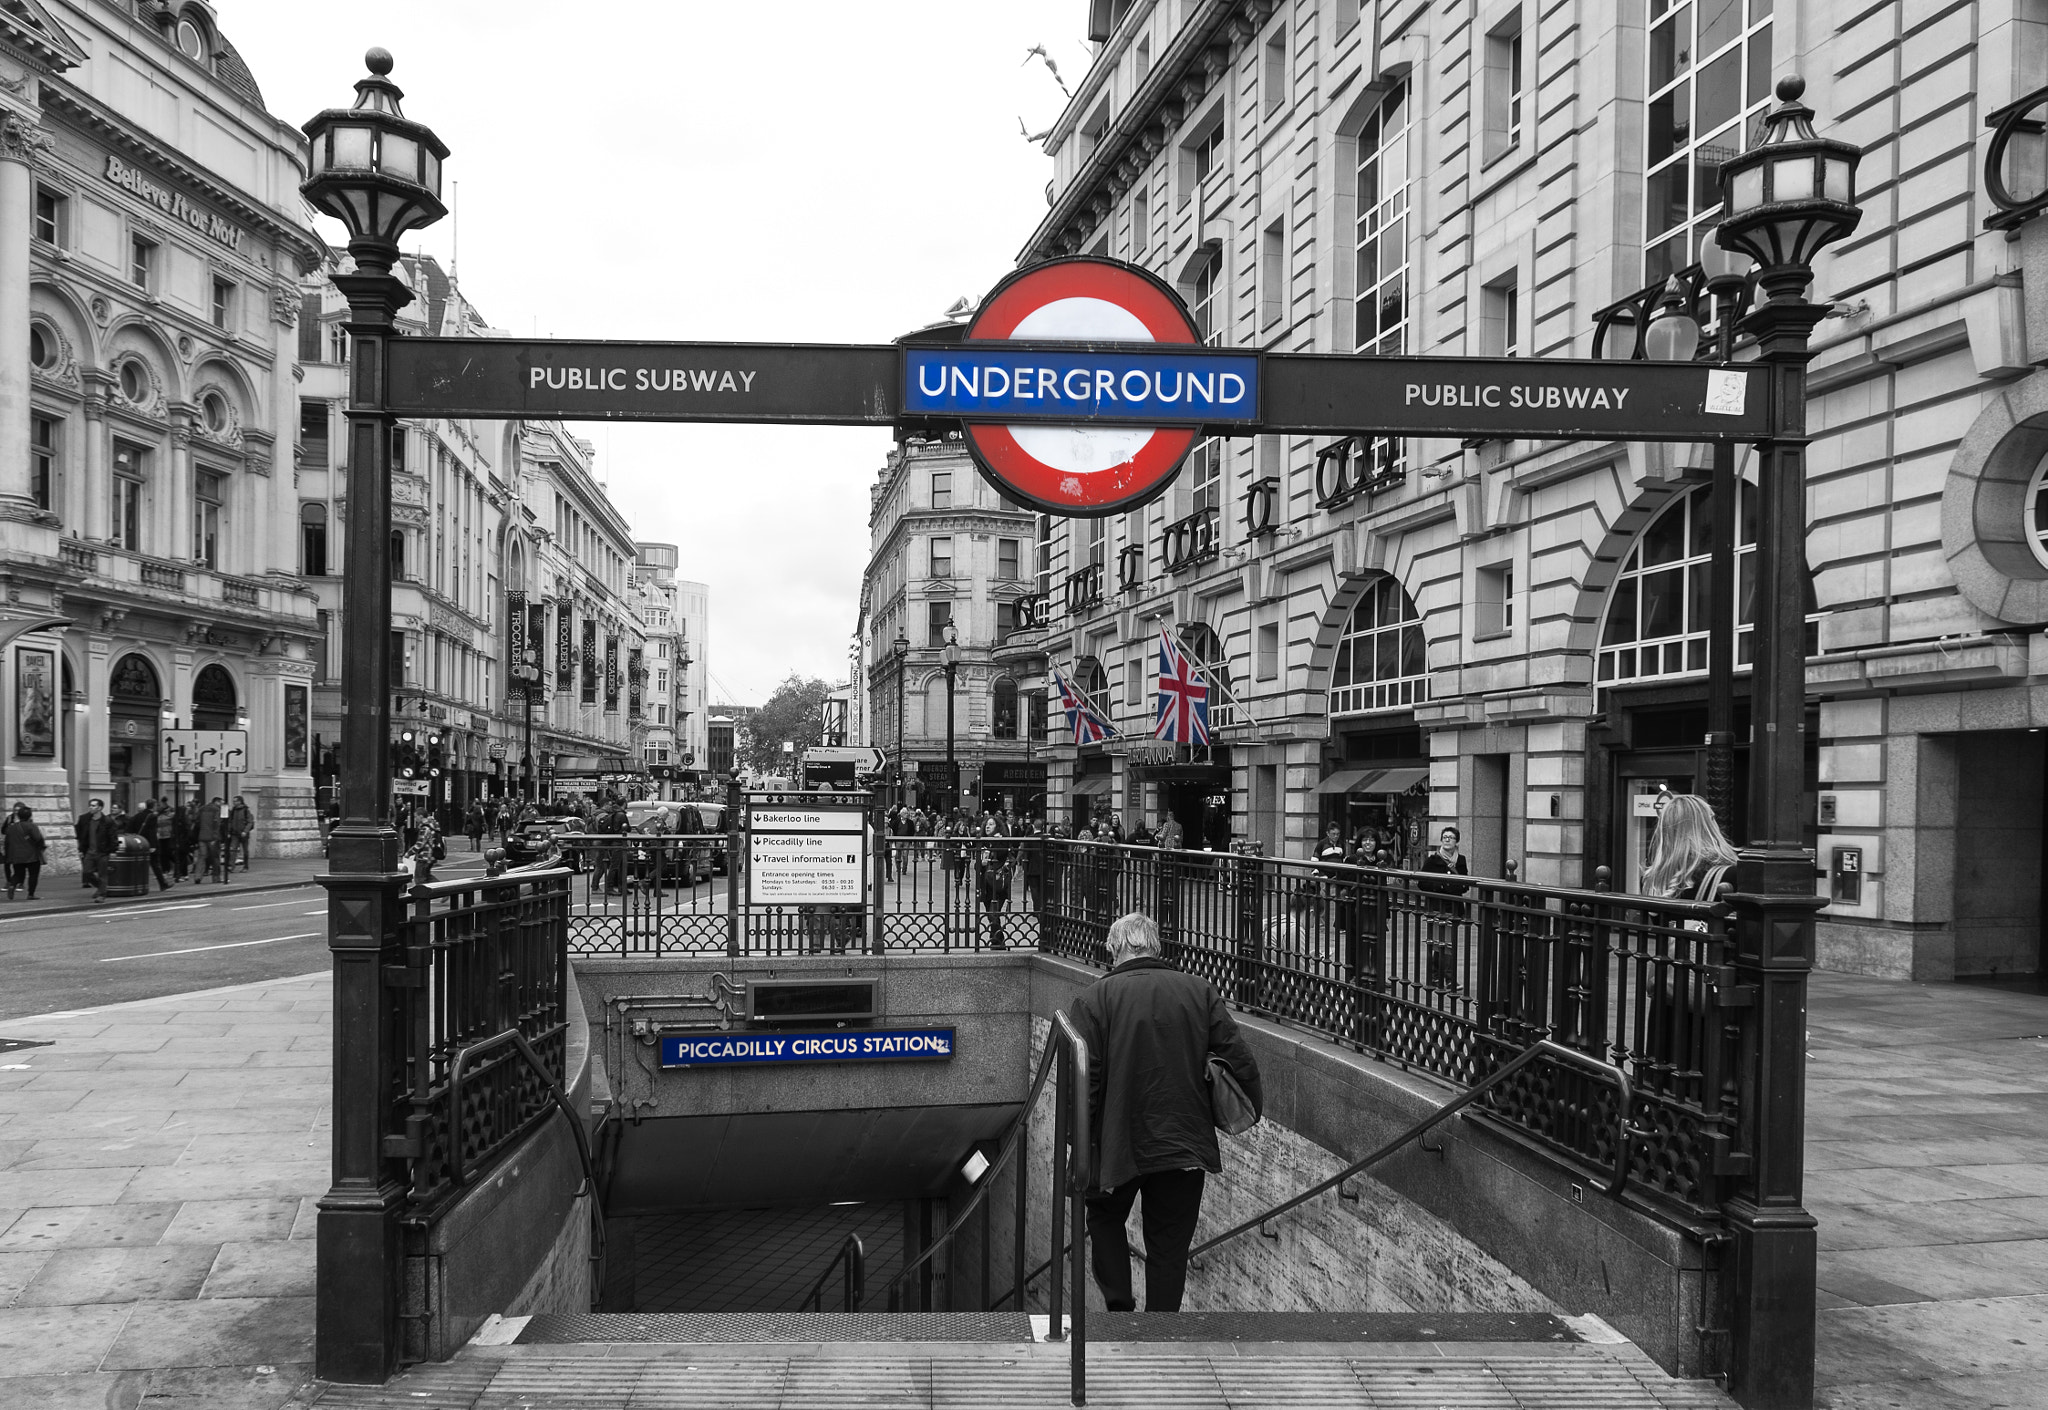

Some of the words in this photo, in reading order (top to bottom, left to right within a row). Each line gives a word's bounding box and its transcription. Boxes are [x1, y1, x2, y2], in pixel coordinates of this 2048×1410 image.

[106, 155, 172, 212] Believe
[171, 191, 189, 221] It
[189, 209, 210, 232] or
[208, 213, 245, 250] Not!
[530, 367, 626, 391] PUBLIC
[635, 368, 757, 393] SUBWAY
[919, 365, 1246, 404] UNDERGROUND
[1405, 384, 1500, 408] PUBLIC
[1508, 385, 1630, 410] SUBWAY
[511, 611, 522, 676] TROCADERO
[560, 615, 569, 671] TROCADERO
[608, 649, 616, 695] TROCADERO
[852, 701, 859, 711] OF
[763, 814, 802, 823] Bakerloo
[804, 814, 821, 823] line
[762, 837, 804, 847] Piccadilly
[806, 837, 823, 846] line
[762, 854, 789, 863] Travel
[791, 854, 843, 863] information
[678, 1040, 786, 1058] PICCADILLY
[791, 1037, 858, 1055] CIRCUS
[862, 1035, 938, 1053] STATION
